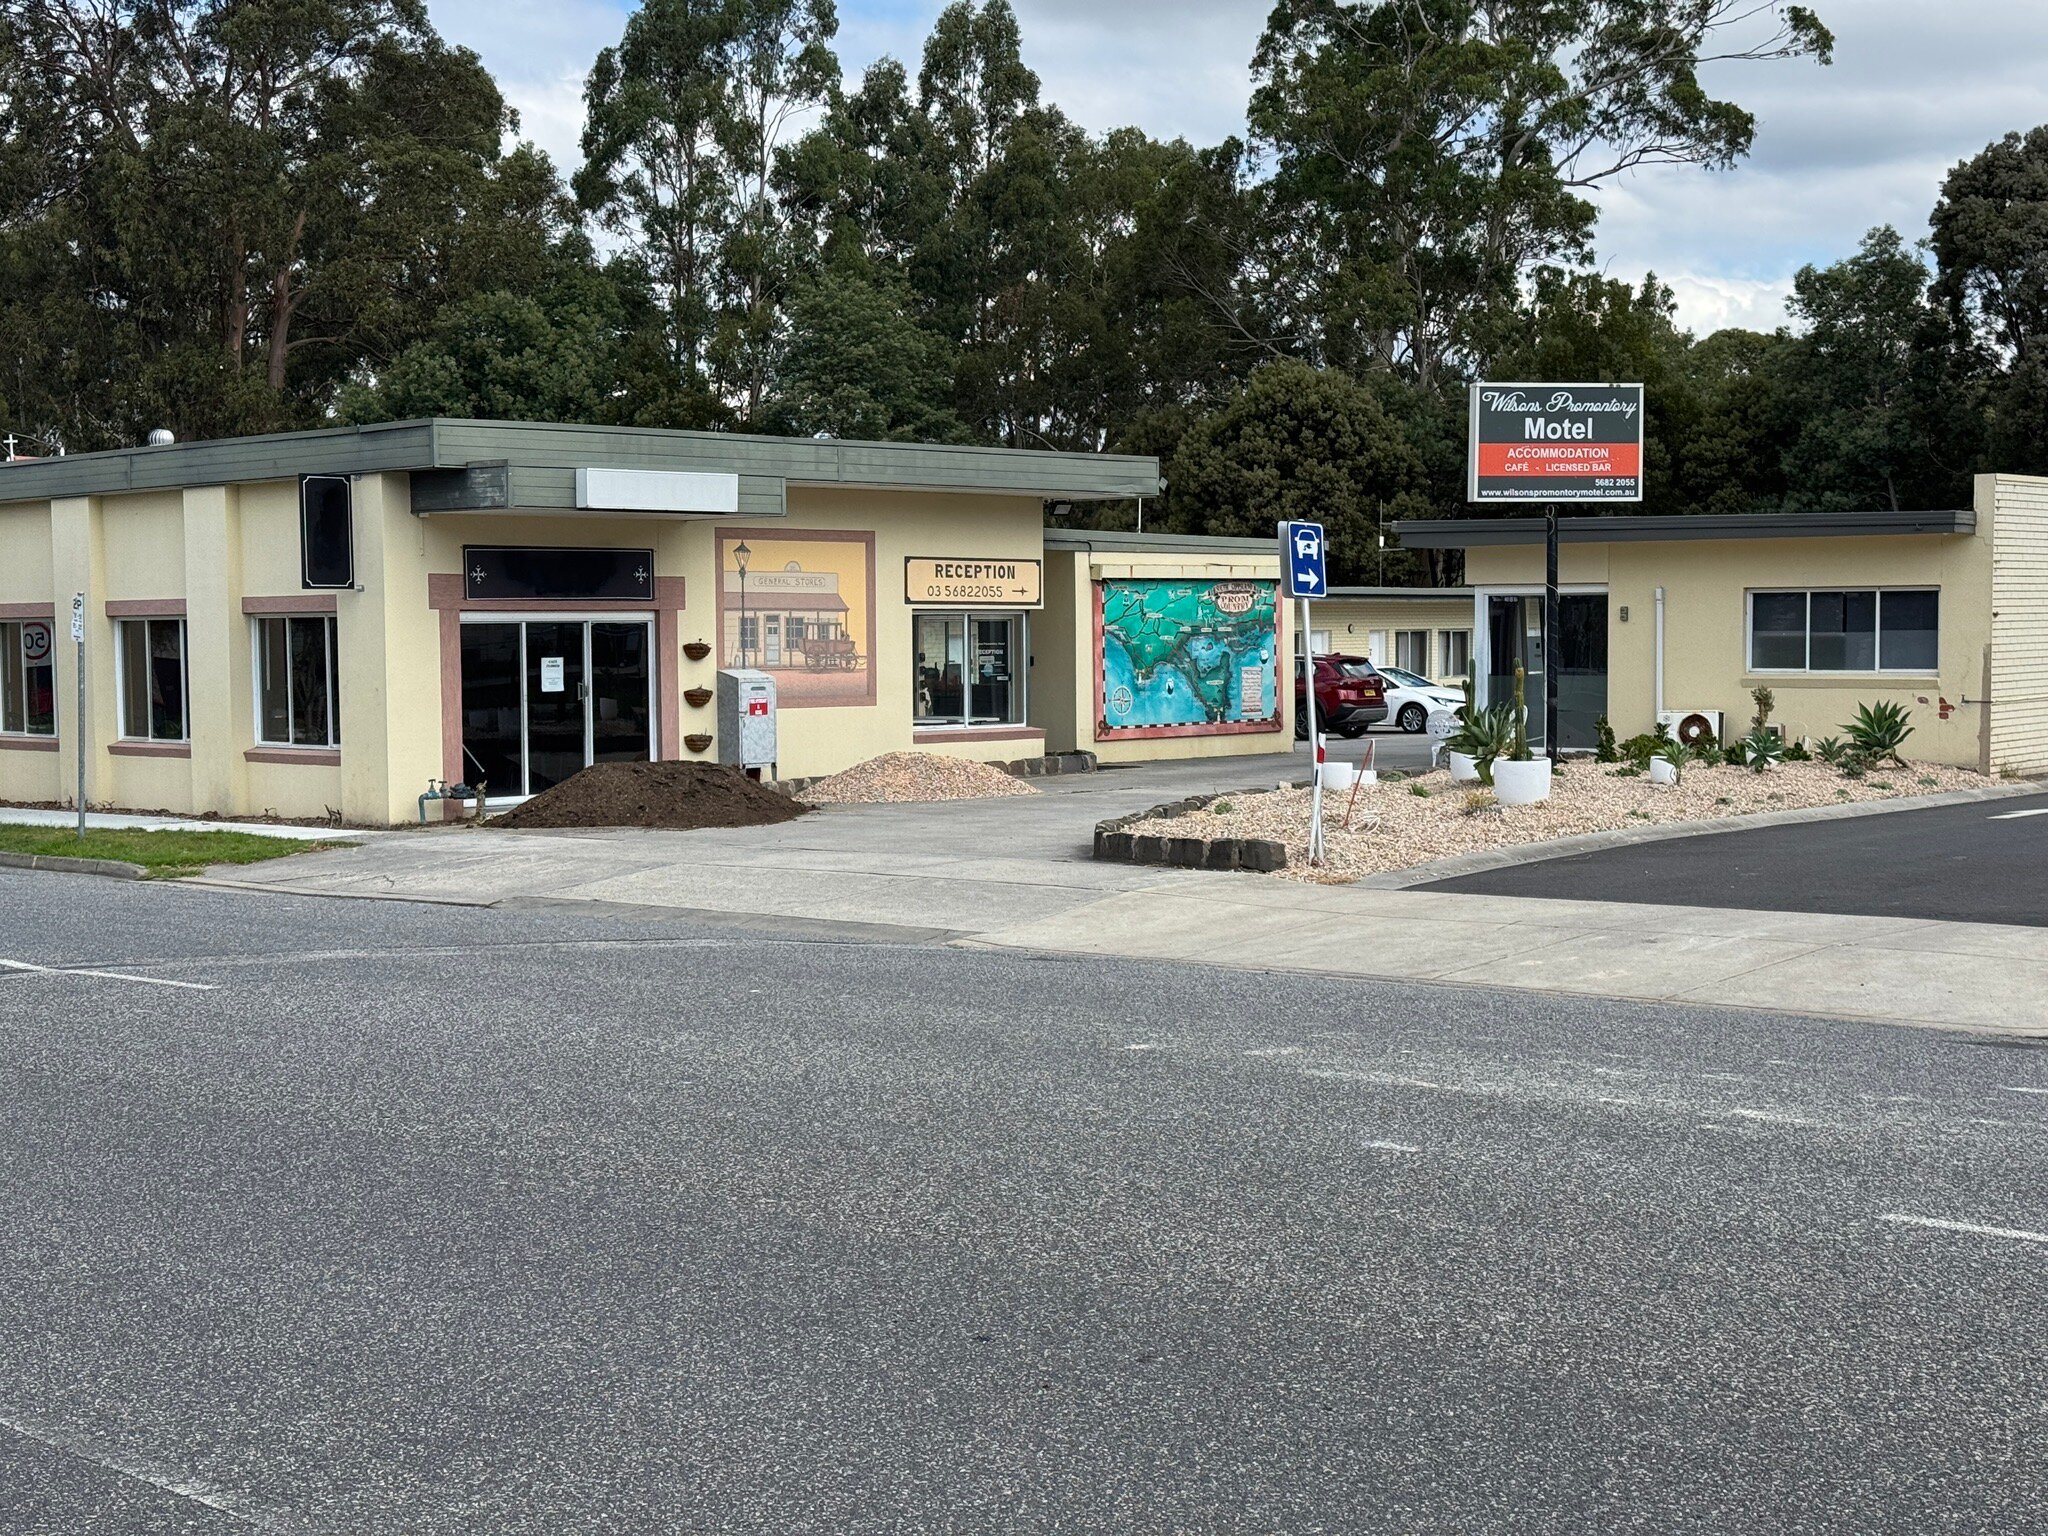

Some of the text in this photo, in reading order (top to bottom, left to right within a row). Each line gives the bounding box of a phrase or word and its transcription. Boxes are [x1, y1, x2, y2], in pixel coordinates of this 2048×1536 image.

[1482, 391, 1637, 419] Wilsons Promontory
[1525, 417, 1593, 440] Motel
[1507, 448, 1609, 458] ACCOMMODATION
[1505, 462, 1529, 472] CAFÉ
[1546, 463, 1590, 472] LICENSED
[1592, 463, 1612, 472] BAR
[1595, 479, 1635, 487] 5682 2055
[1481, 489, 1635, 498] www.wilsonspromontorymotel.com.au
[935, 563, 1015, 579] RECEPTION
[758, 577, 823, 586] GENERAL STORES
[927, 585, 1003, 598] 03 56822055
[1221, 595, 1249, 603] PROM
